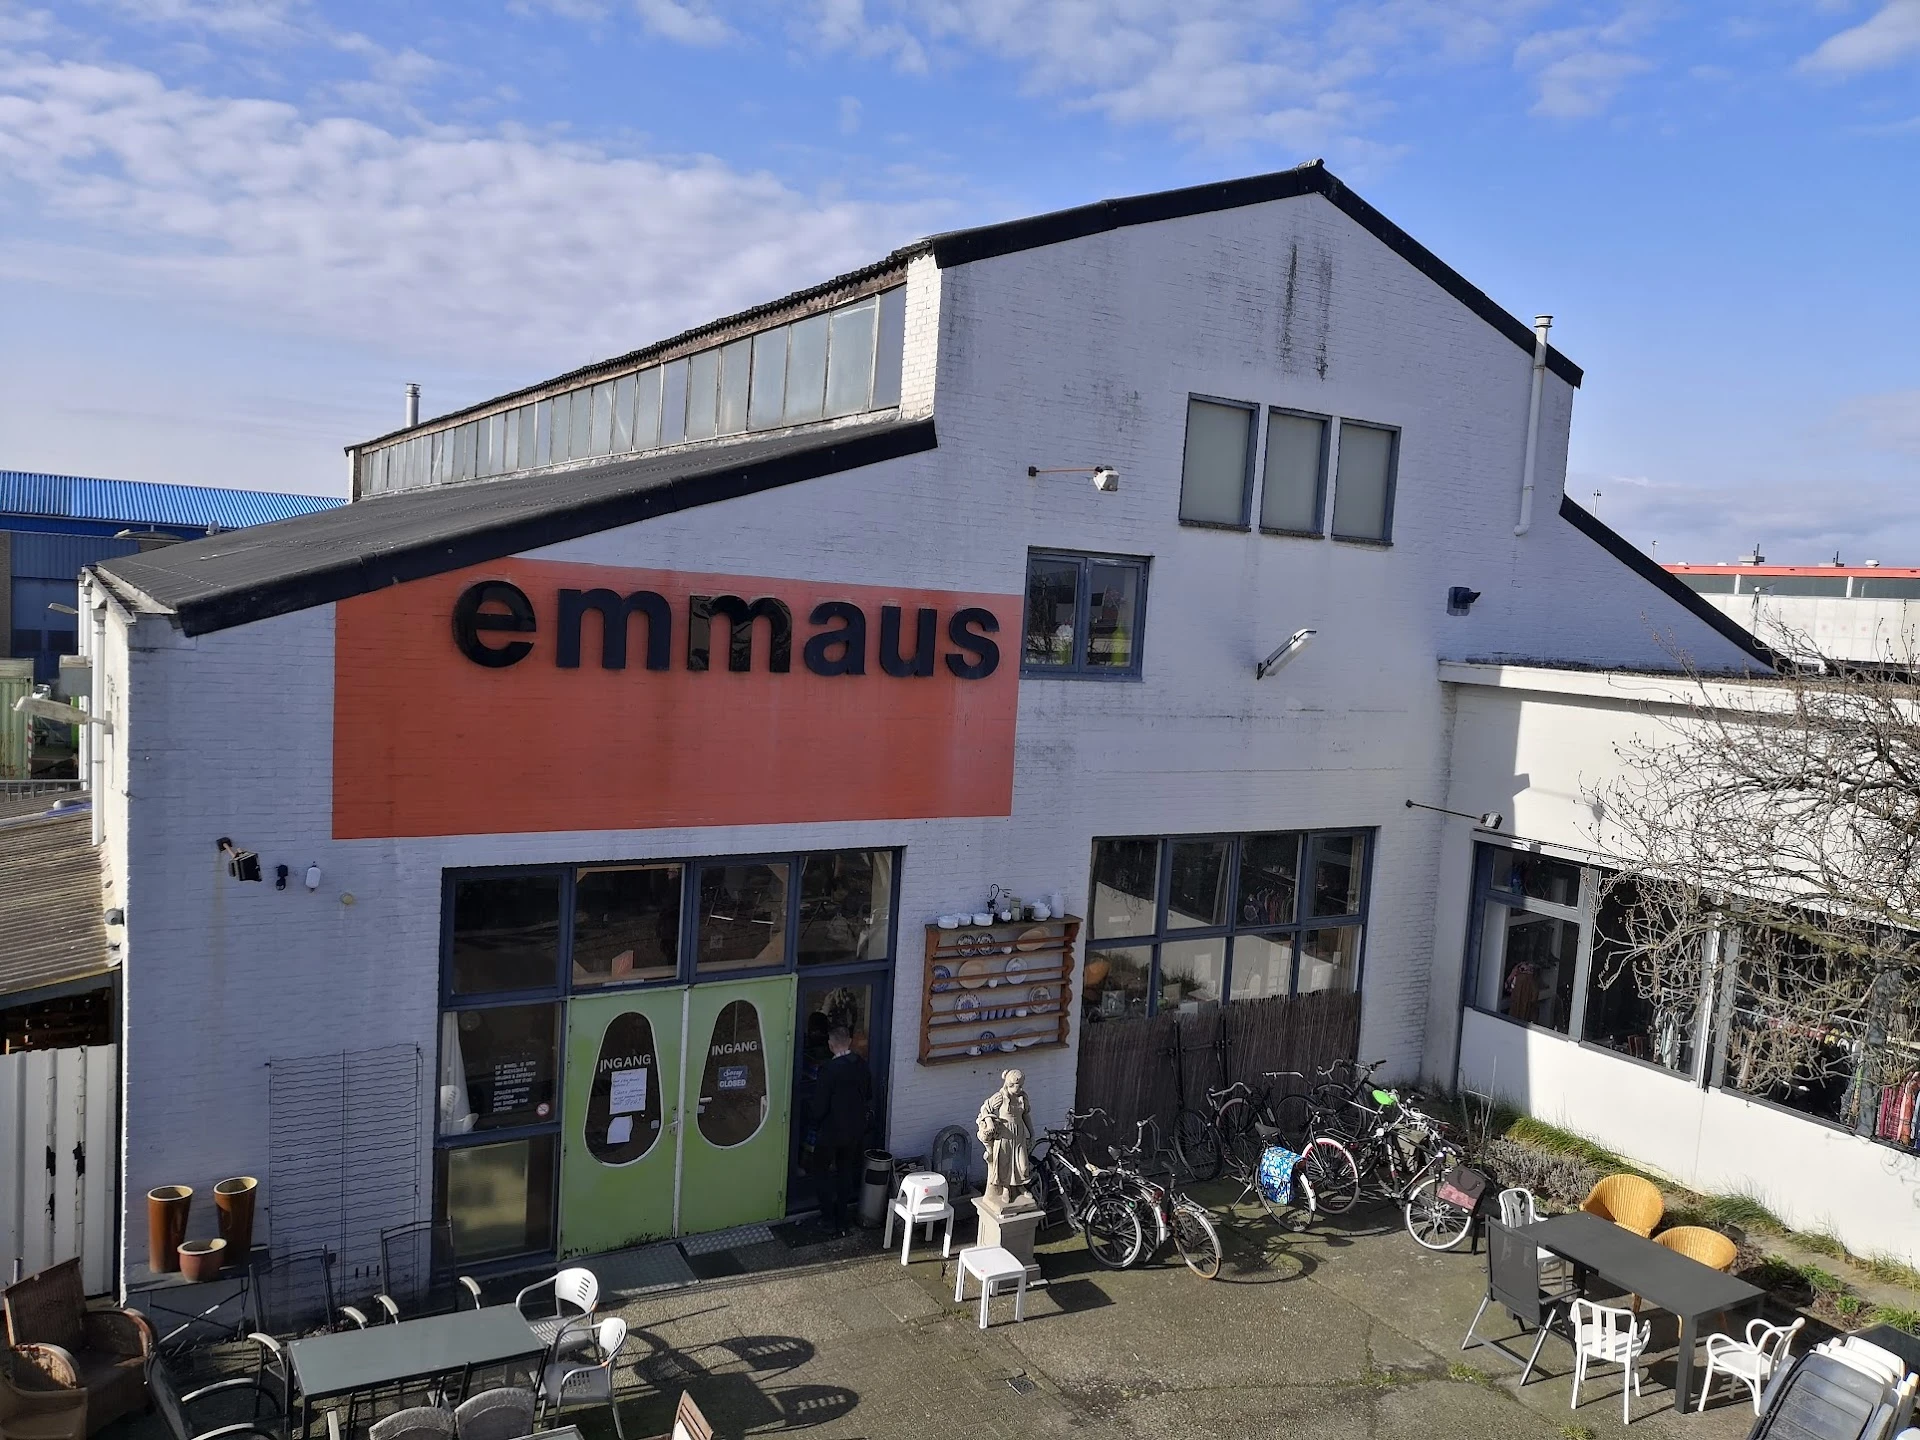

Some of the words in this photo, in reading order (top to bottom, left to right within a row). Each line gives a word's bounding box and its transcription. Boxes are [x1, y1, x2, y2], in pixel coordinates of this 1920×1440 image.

[452, 579, 1000, 680] emmaus
[711, 1041, 757, 1056] INGANG
[600, 1054, 651, 1073] INGANG
[723, 1069, 743, 1078] Sorry
[719, 1079, 746, 1088] CLOSED
